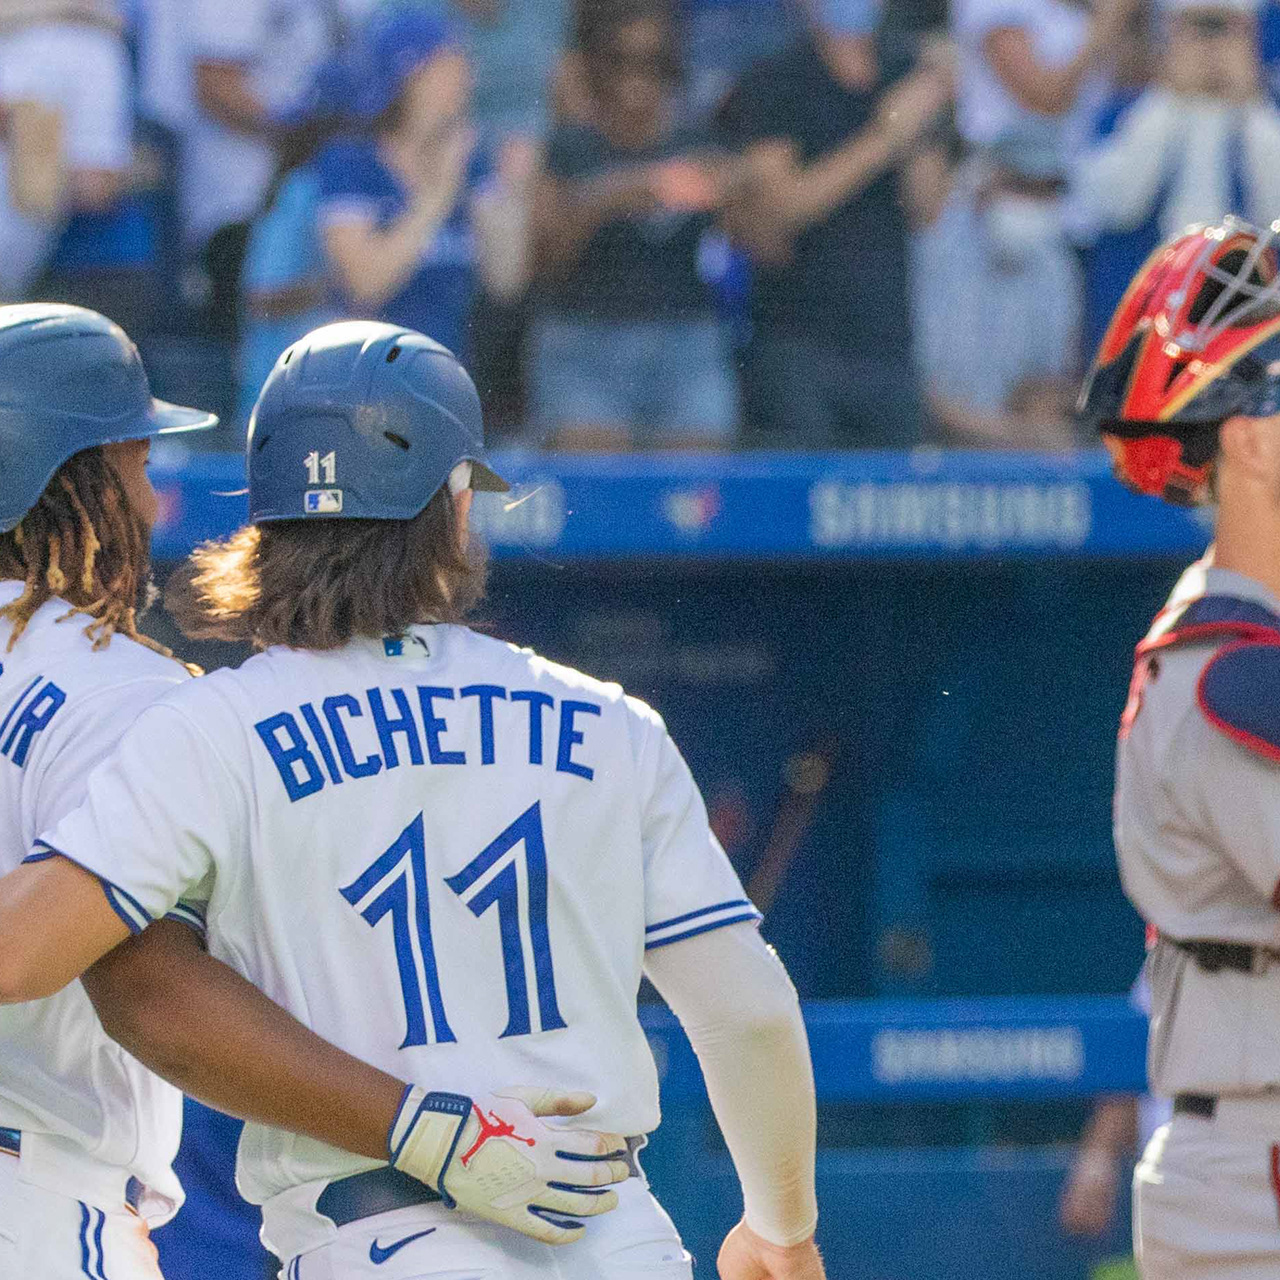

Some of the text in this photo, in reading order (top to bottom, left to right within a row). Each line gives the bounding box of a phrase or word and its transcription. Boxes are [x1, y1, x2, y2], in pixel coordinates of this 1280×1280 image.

[303, 450, 336, 484] 11
[254, 683, 602, 803] BICHETTE
[338, 799, 568, 1050] 11
